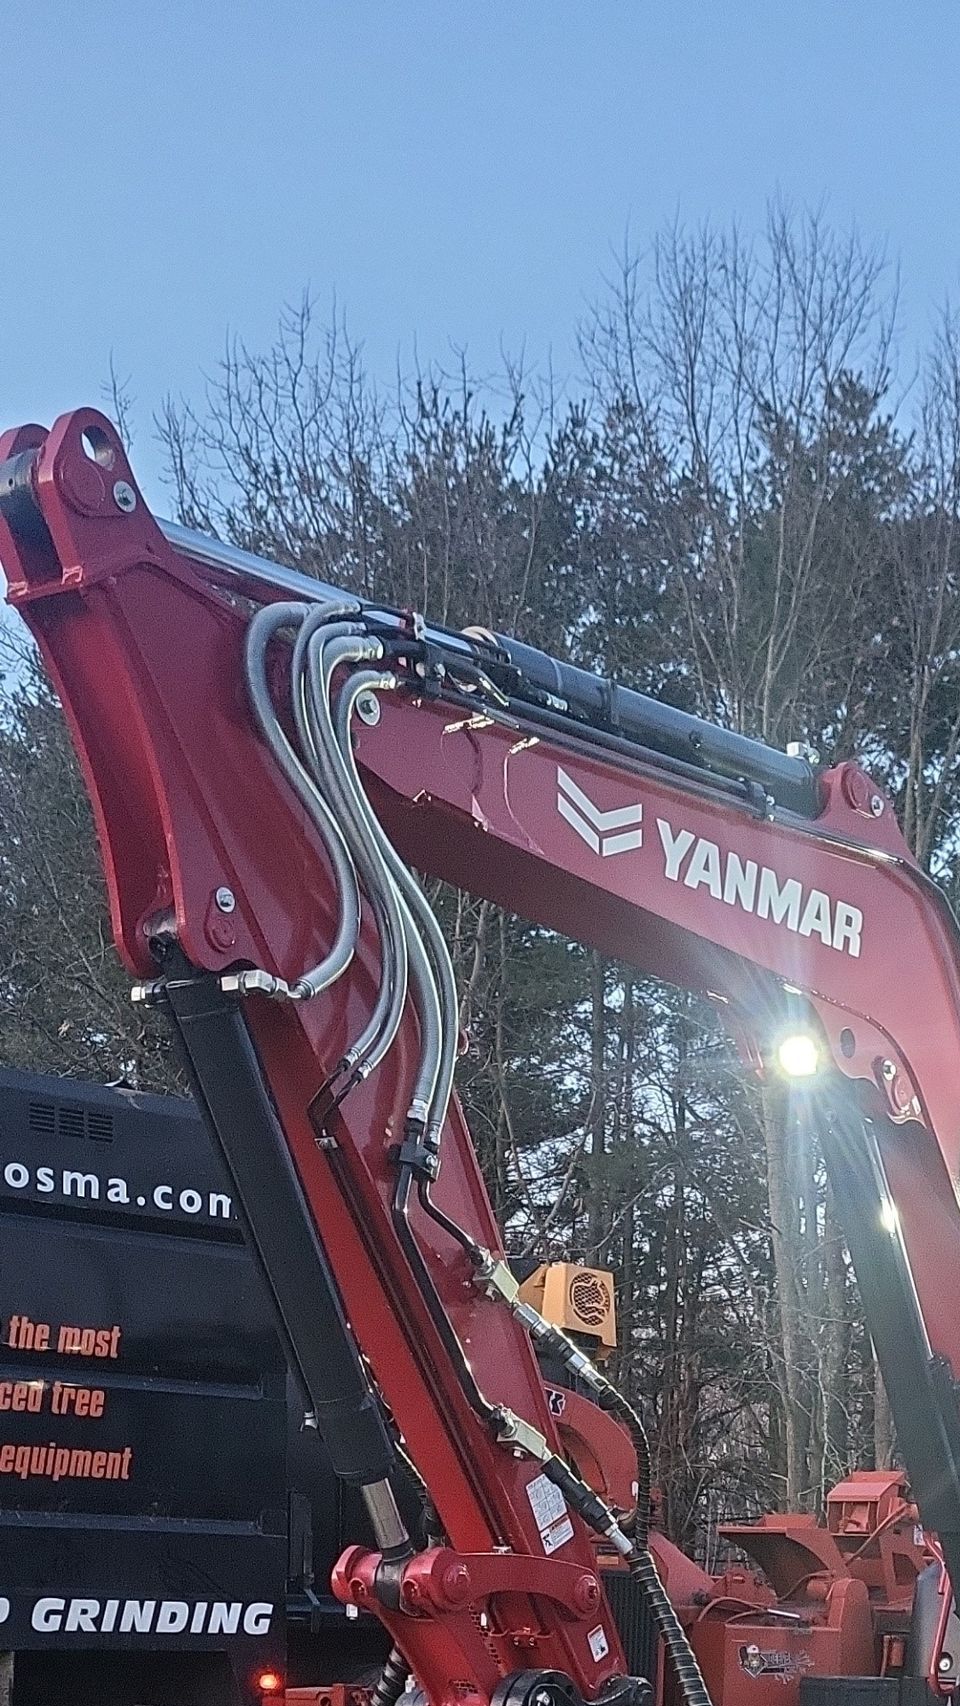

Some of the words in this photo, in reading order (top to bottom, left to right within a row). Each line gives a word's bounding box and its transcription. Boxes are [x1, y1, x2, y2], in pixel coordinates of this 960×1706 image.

[656, 817, 864, 959] YANMAR
[9, 1315, 50, 1351] the
[57, 1325, 121, 1358] most
[51, 1380, 105, 1417] tree
[0, 1442, 132, 1481] equipment
[31, 1597, 274, 1635] GRINDING
